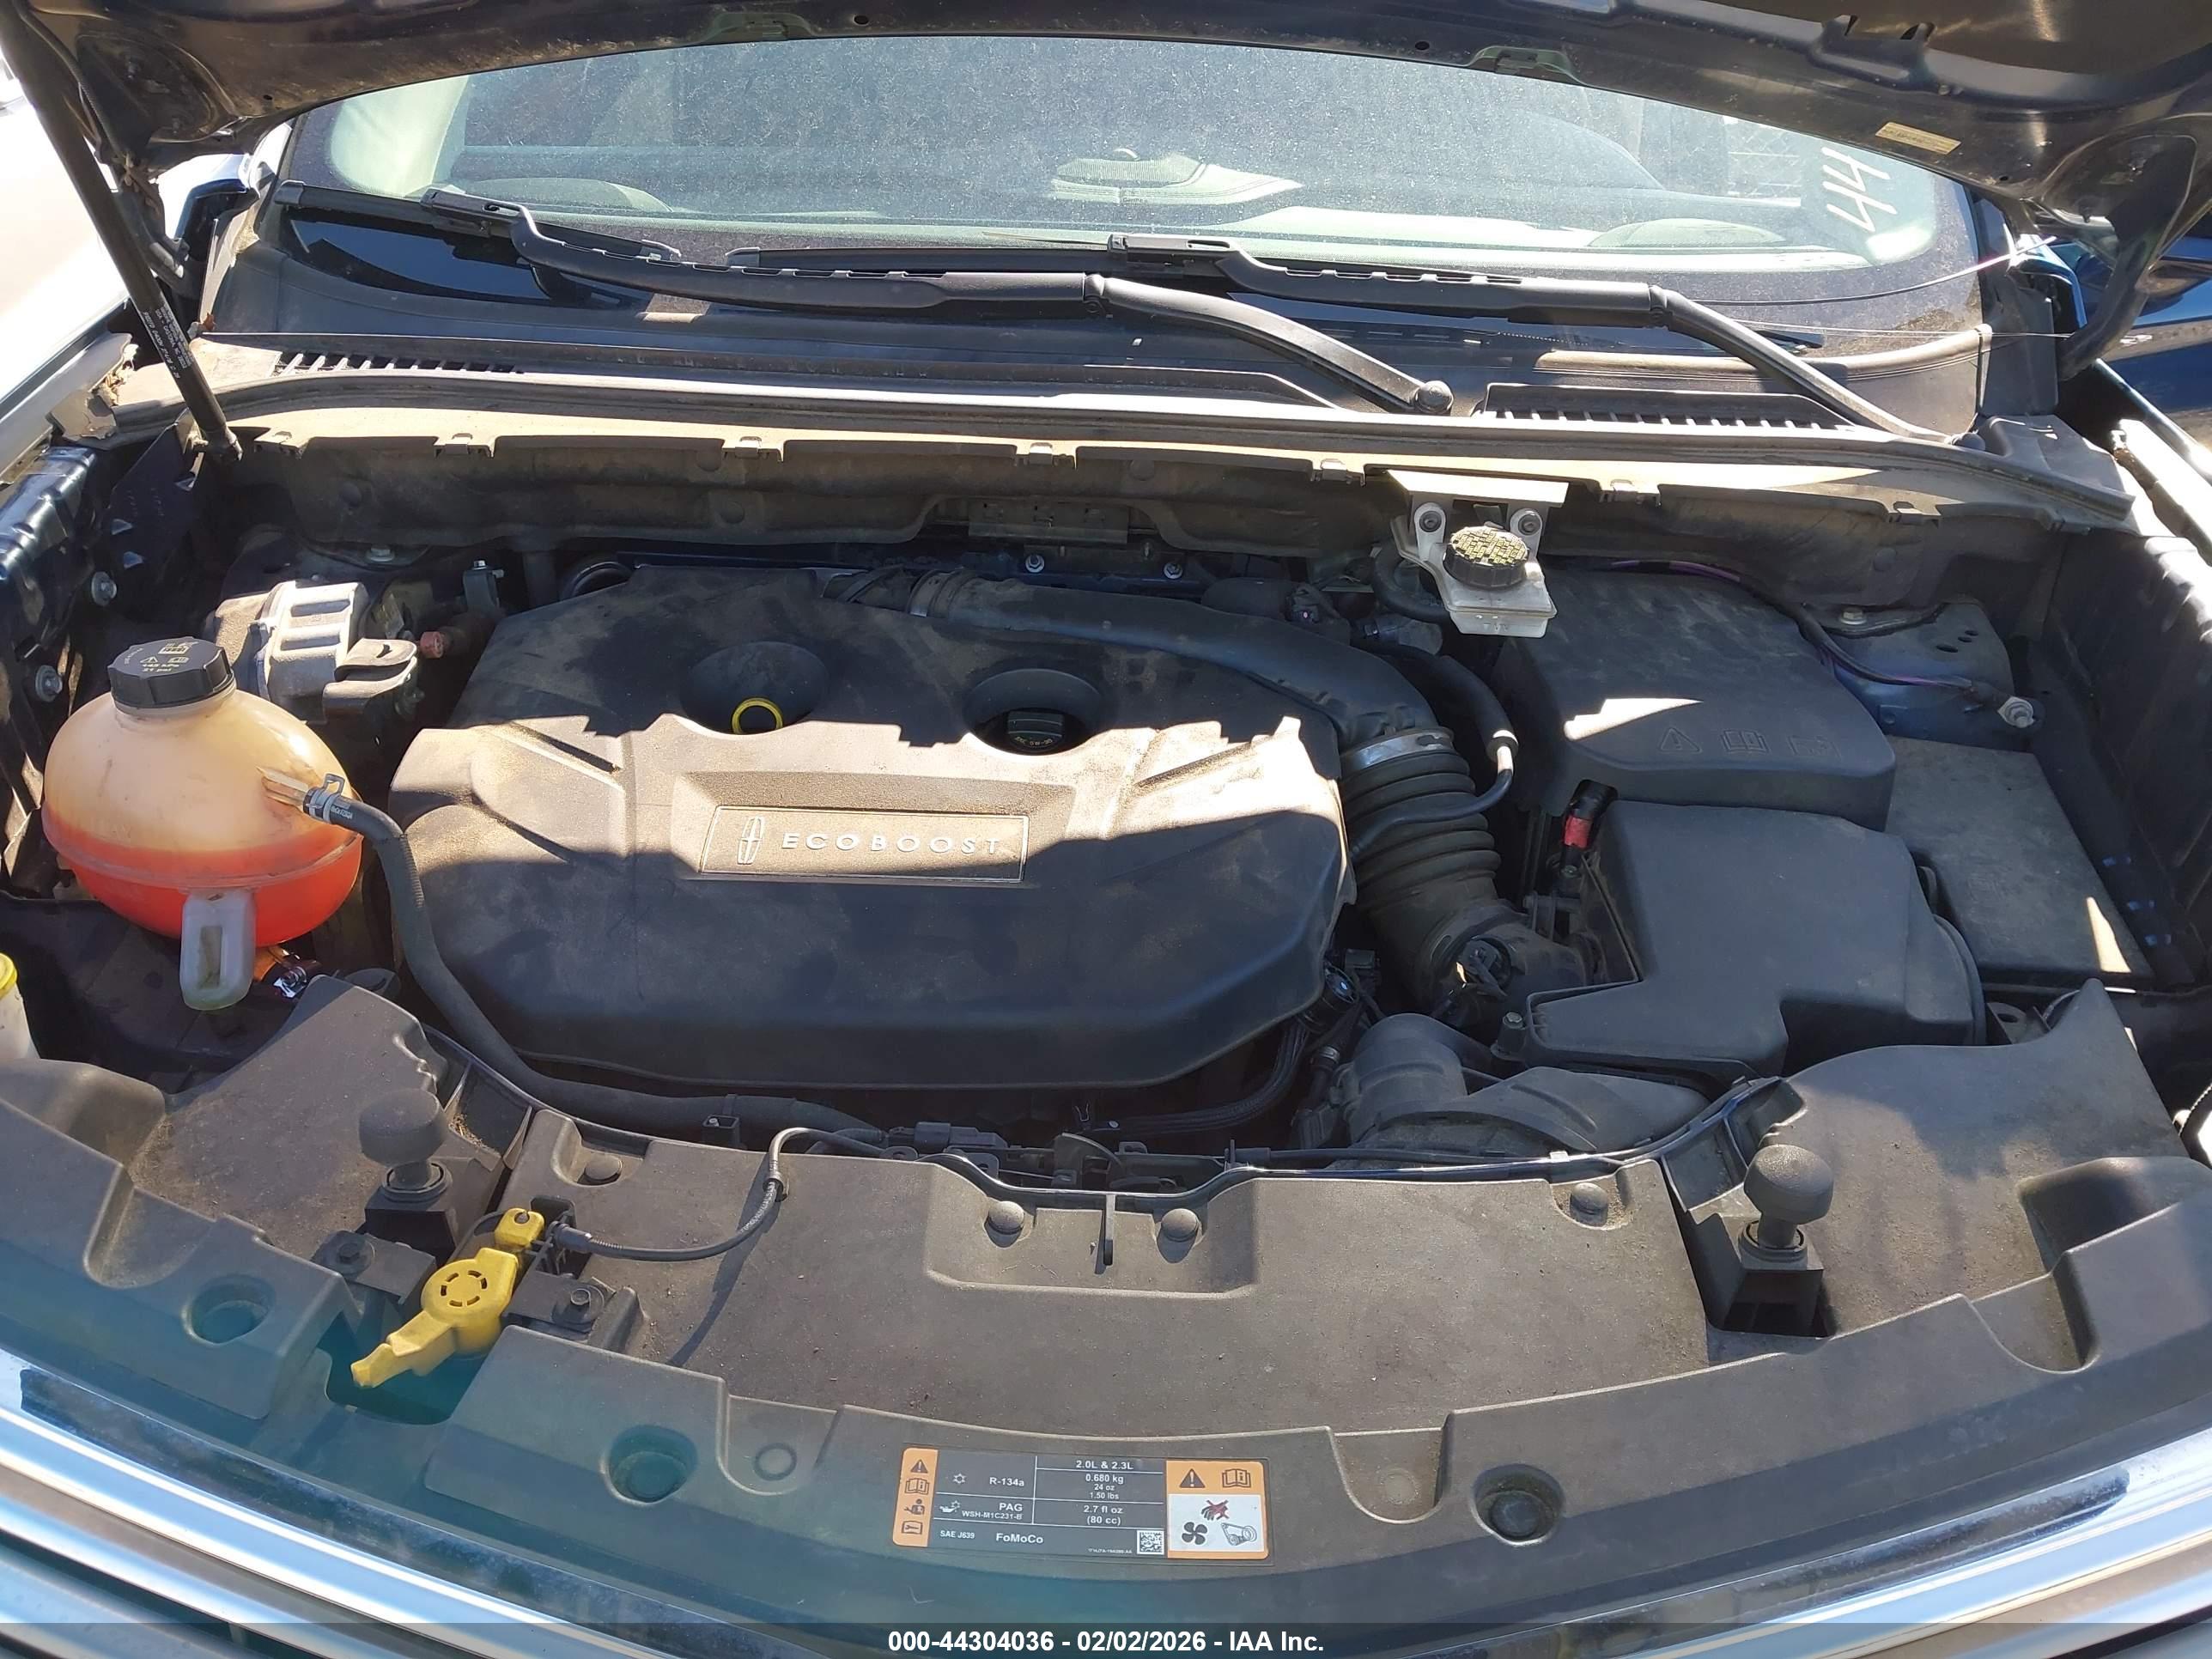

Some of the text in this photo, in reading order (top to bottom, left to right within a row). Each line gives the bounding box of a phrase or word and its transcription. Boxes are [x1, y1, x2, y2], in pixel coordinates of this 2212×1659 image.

[781, 832, 1000, 854] ECOBOOST
[1075, 1460, 1097, 1468] 2.0L
[1111, 1462, 1133, 1470] 2.3L
[989, 1476, 1024, 1486] R-134a
[1085, 1474, 1124, 1485] 0.680 kg
[999, 1502, 1023, 1512] PAG
[1083, 1504, 1099, 1513] 2.7
[1101, 1505, 1108, 1514] fl
[962, 1510, 1023, 1520] WSH-M1C231-B
[1087, 1516, 1121, 1527] (80 cc)
[995, 1532, 1044, 1545] FoMoCo
